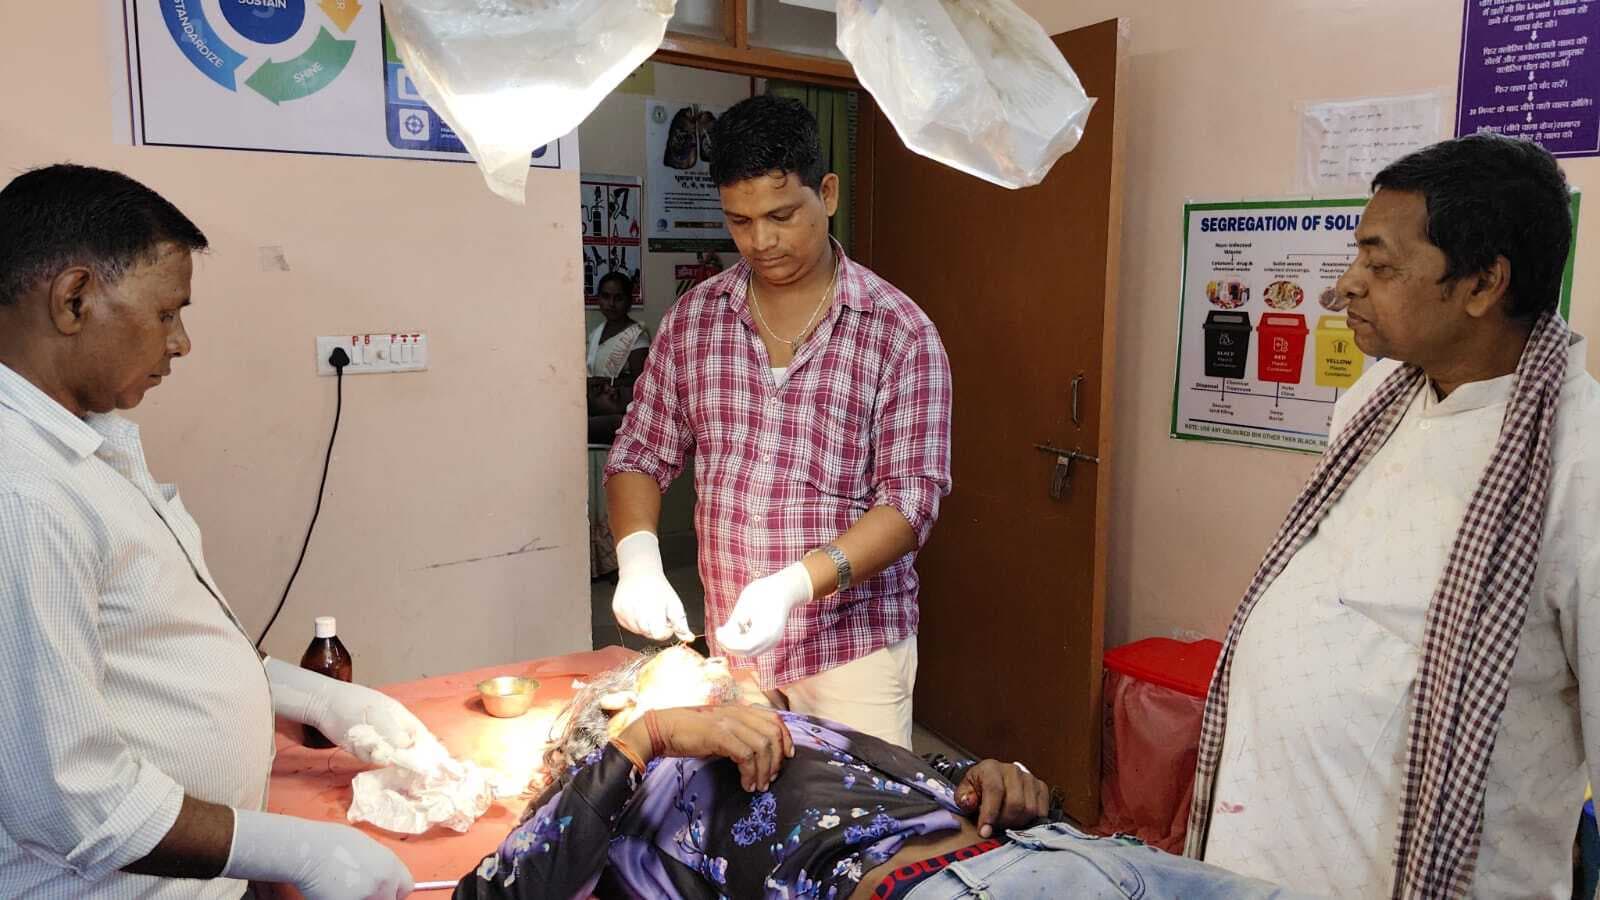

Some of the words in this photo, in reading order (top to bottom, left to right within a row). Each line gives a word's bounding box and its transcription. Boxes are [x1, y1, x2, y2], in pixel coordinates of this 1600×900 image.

[1528, 1, 1550, 10] Liquid
[293, 62, 323, 83] SHINE
[1200, 216, 1297, 232] SEGREGATION
[1302, 215, 1322, 231] OF
[1324, 214, 1360, 230] SOLI
